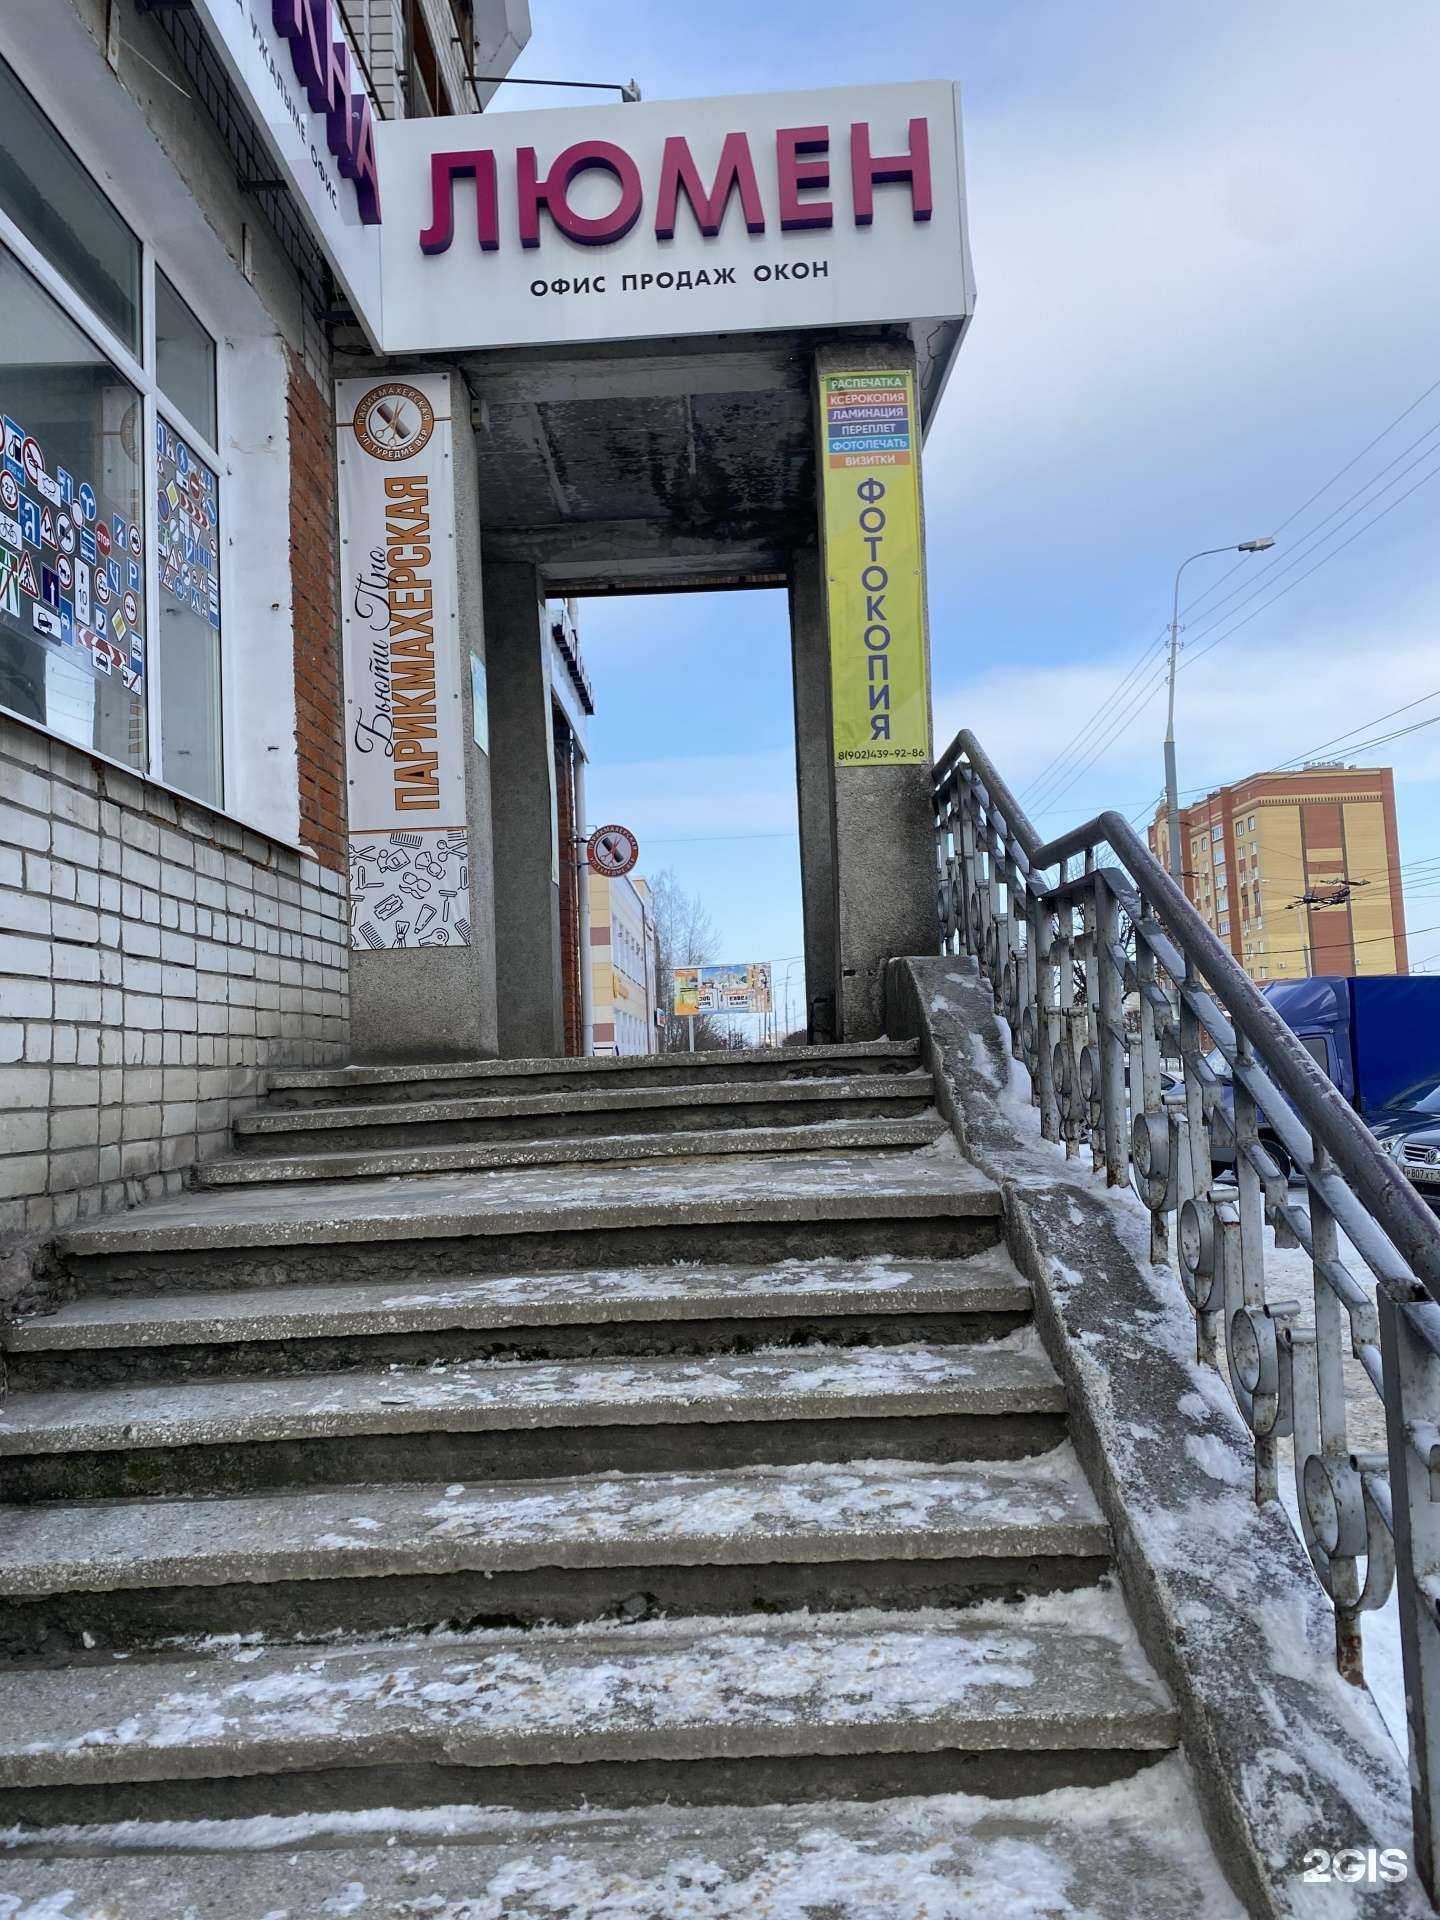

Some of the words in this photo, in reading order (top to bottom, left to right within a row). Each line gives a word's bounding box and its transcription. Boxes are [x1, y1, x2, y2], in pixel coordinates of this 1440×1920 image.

[310, 144, 338, 210] ОФИС
[419, 117, 932, 257] ЛЮМЕН
[530, 274, 607, 298] ОФИС
[621, 265, 738, 293] ПРОДАЖ
[753, 259, 830, 284] ОКОН
[831, 377, 902, 389] РАСПЕЧАТКА
[357, 387, 431, 425] ПАРИКМАХЕРСКАЯ
[830, 393, 905, 405] КСЕРОКОПИЯ
[832, 407, 904, 420] ЛАМИНАЦИЯ
[841, 423, 896, 435] ПЕРЕПЛЕТ
[832, 438, 907, 451] ФОТОПЕЧАТЬ
[844, 455, 896, 466] ВИЗИТКИ
[97, 530, 110, 548] STOP
[78, 588, 88, 606] 10
[355, 546, 398, 631] Про
[857, 477, 891, 740] ФОТОКОПИЯ
[383, 475, 441, 811] ПАРИКМАХЕРСКАЯ
[838, 748, 925, 761] 8(902)439-92-86
